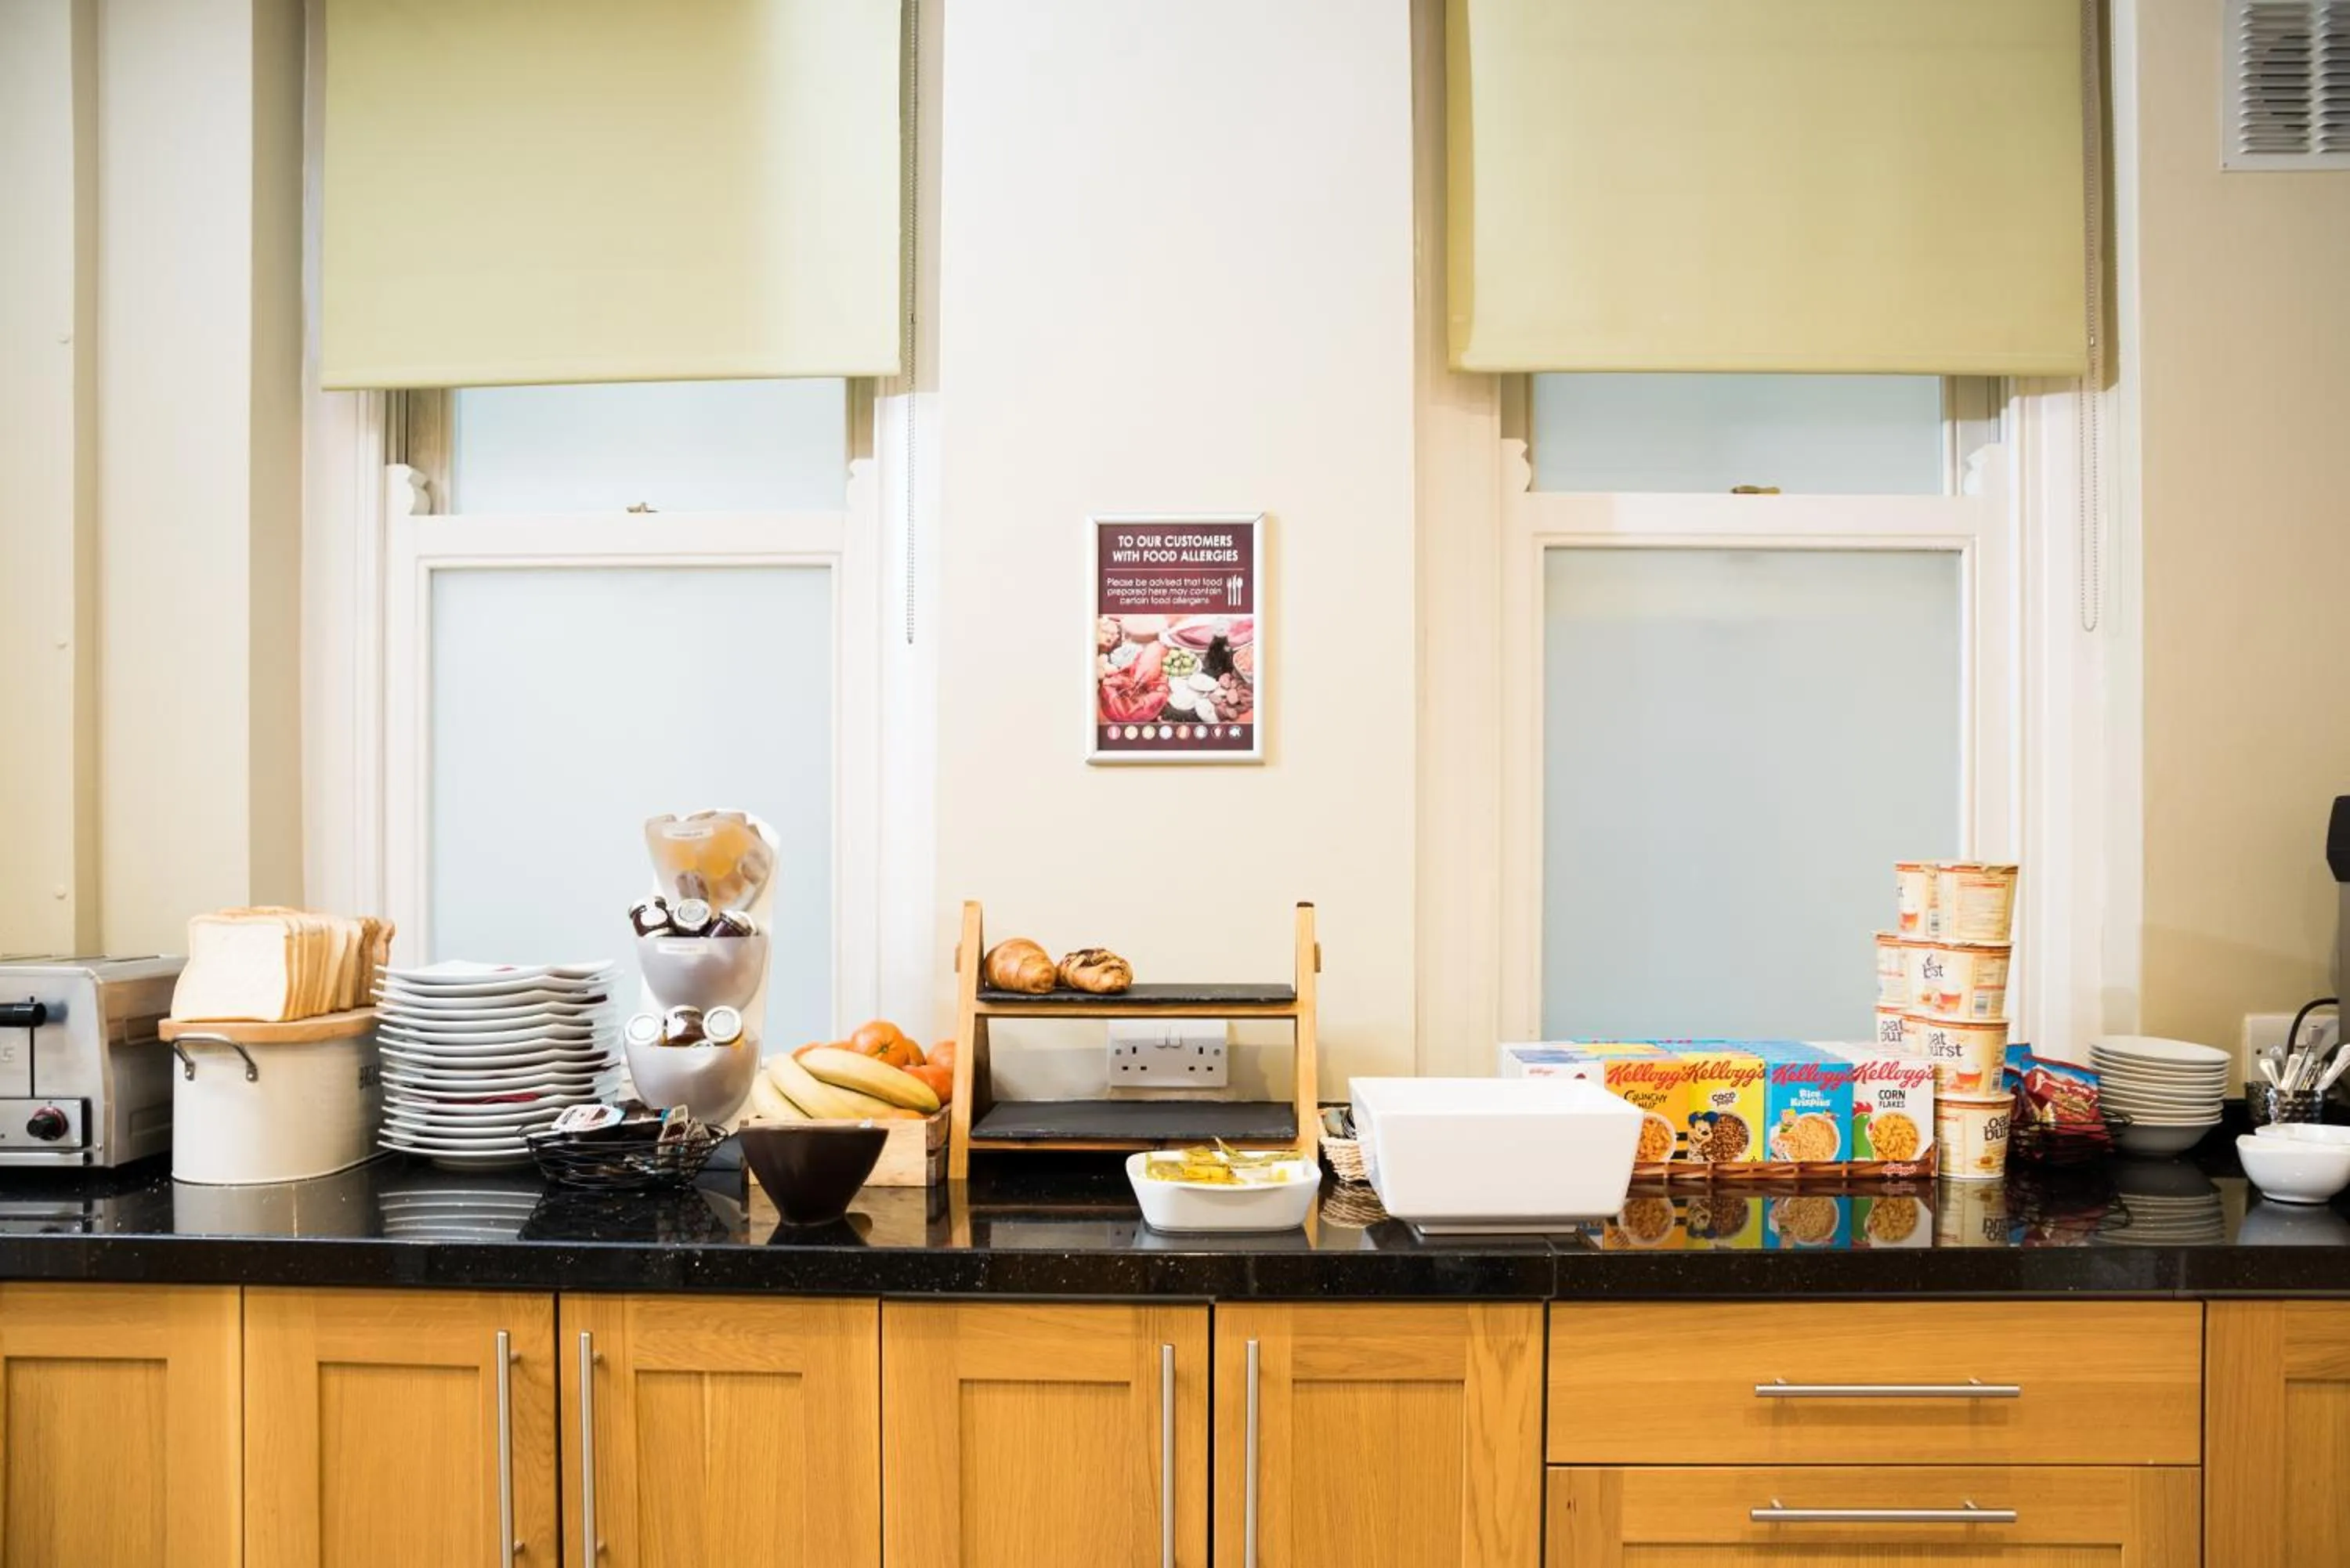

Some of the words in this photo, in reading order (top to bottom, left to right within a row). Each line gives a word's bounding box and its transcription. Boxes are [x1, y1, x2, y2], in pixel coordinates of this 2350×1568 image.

[1118, 535, 1133, 547] TO
[1137, 535, 1162, 547] OUR
[1165, 535, 1233, 547] CUSTOMERS
[1112, 550, 1140, 562] WITH
[1143, 550, 1177, 562] FOOD
[1180, 550, 1238, 562] ALLERGIES
[1107, 577, 1133, 587] Please
[1135, 577, 1148, 587] be
[1149, 577, 1182, 587] advised
[1184, 577, 1201, 587] that
[1202, 577, 1223, 587] food
[1107, 587, 1147, 597] prepared
[1169, 588, 1188, 597] may
[1190, 587, 1222, 596] contain
[1607, 1062, 1690, 1090] Kellogg's
[1686, 1060, 1766, 1087] Kellogg's
[1772, 1061, 1856, 1090] Kellogg's
[1853, 1060, 1934, 1088] Kellogg's
[1878, 1089, 1905, 1100] CORN
